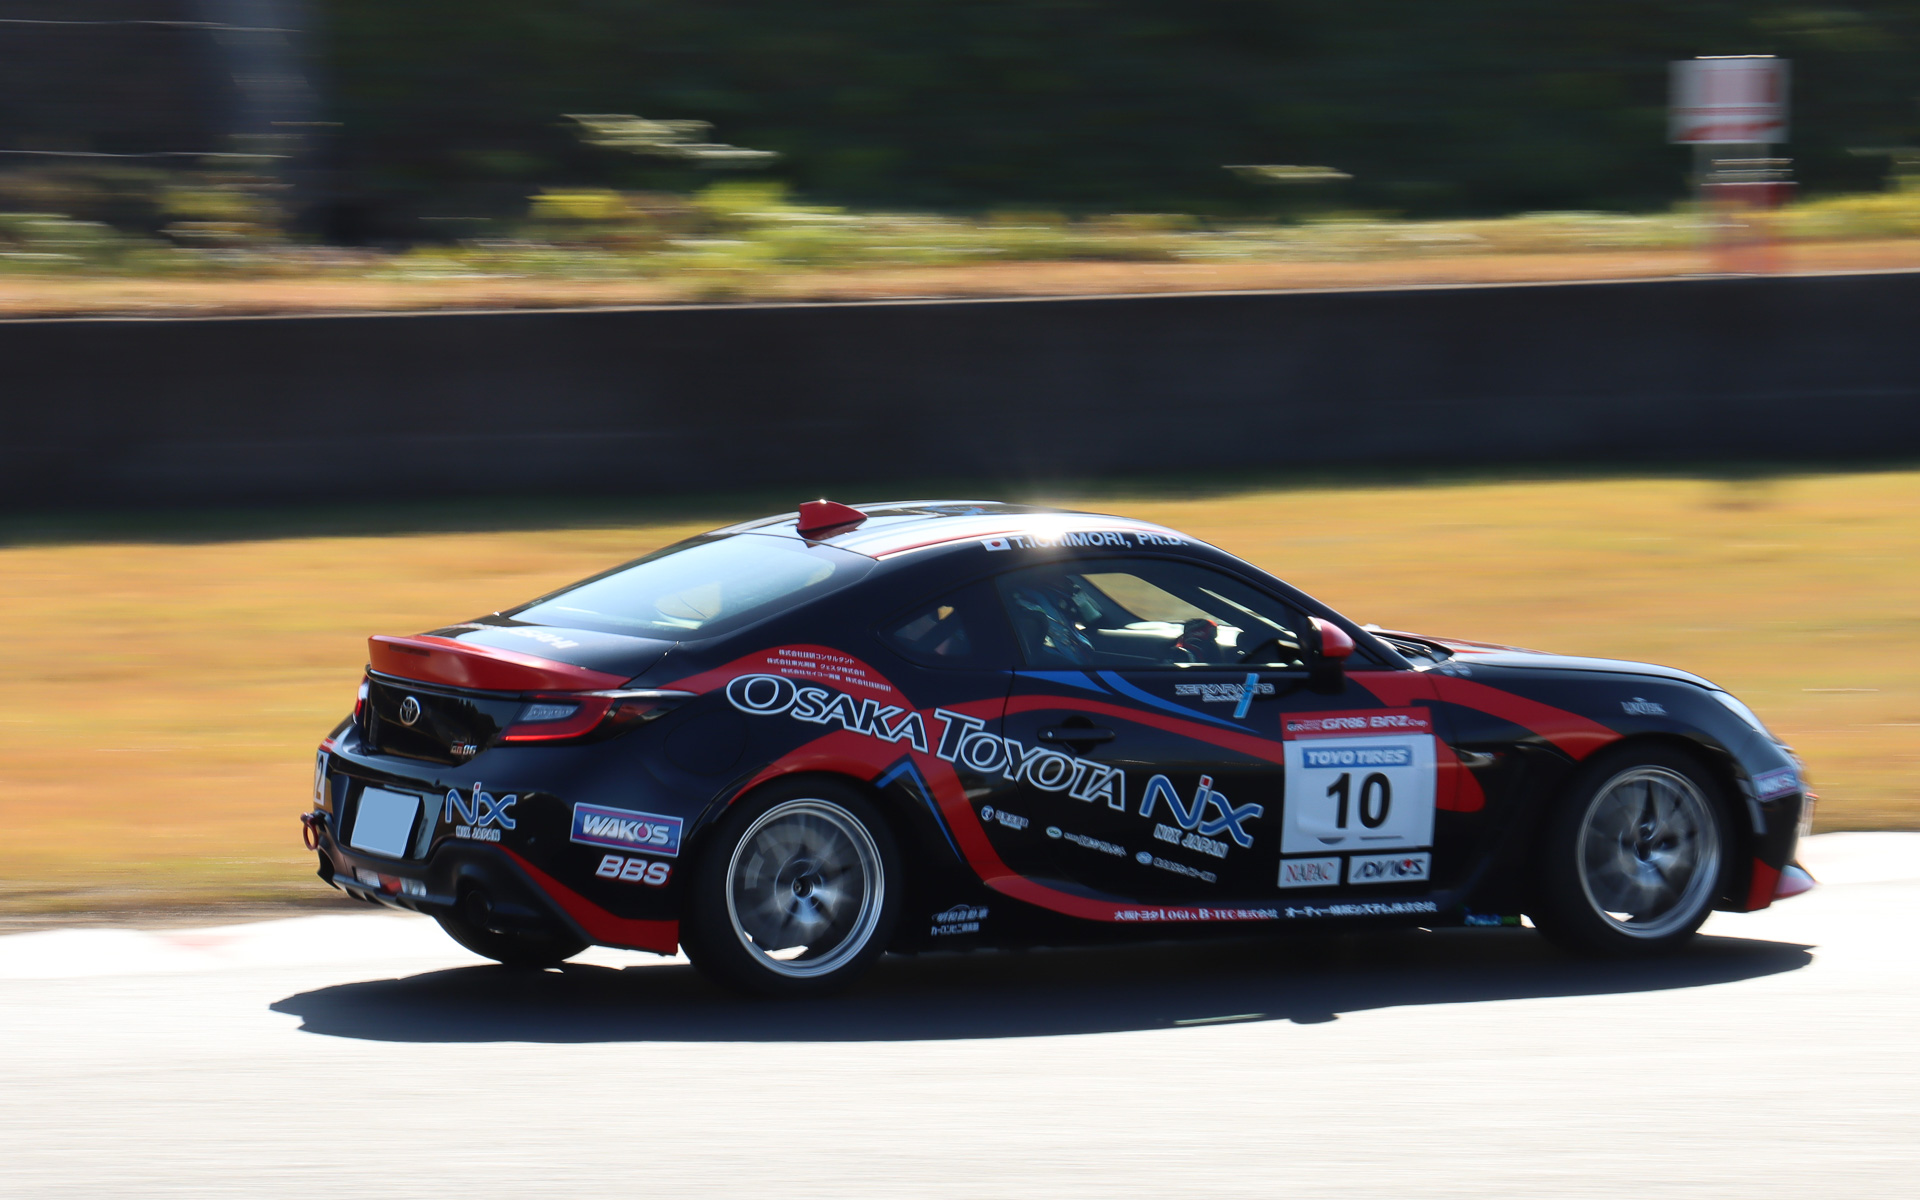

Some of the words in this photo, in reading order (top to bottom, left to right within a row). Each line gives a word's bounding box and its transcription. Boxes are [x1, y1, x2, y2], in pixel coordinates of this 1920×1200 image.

[1136, 533, 1189, 546] Ph.D.
[726, 673, 929, 753] OSAKA
[934, 708, 1126, 811] TOYOTA
[1307, 750, 1356, 766] TOYO
[1356, 749, 1409, 764] TIRES
[1326, 772, 1392, 829] 10
[472, 826, 501, 842] JAPAN
[1153, 823, 1183, 845] NIX
[1181, 832, 1229, 859] JAPAN
[595, 854, 671, 886] BBS
[1285, 862, 1335, 882] NAPAC
